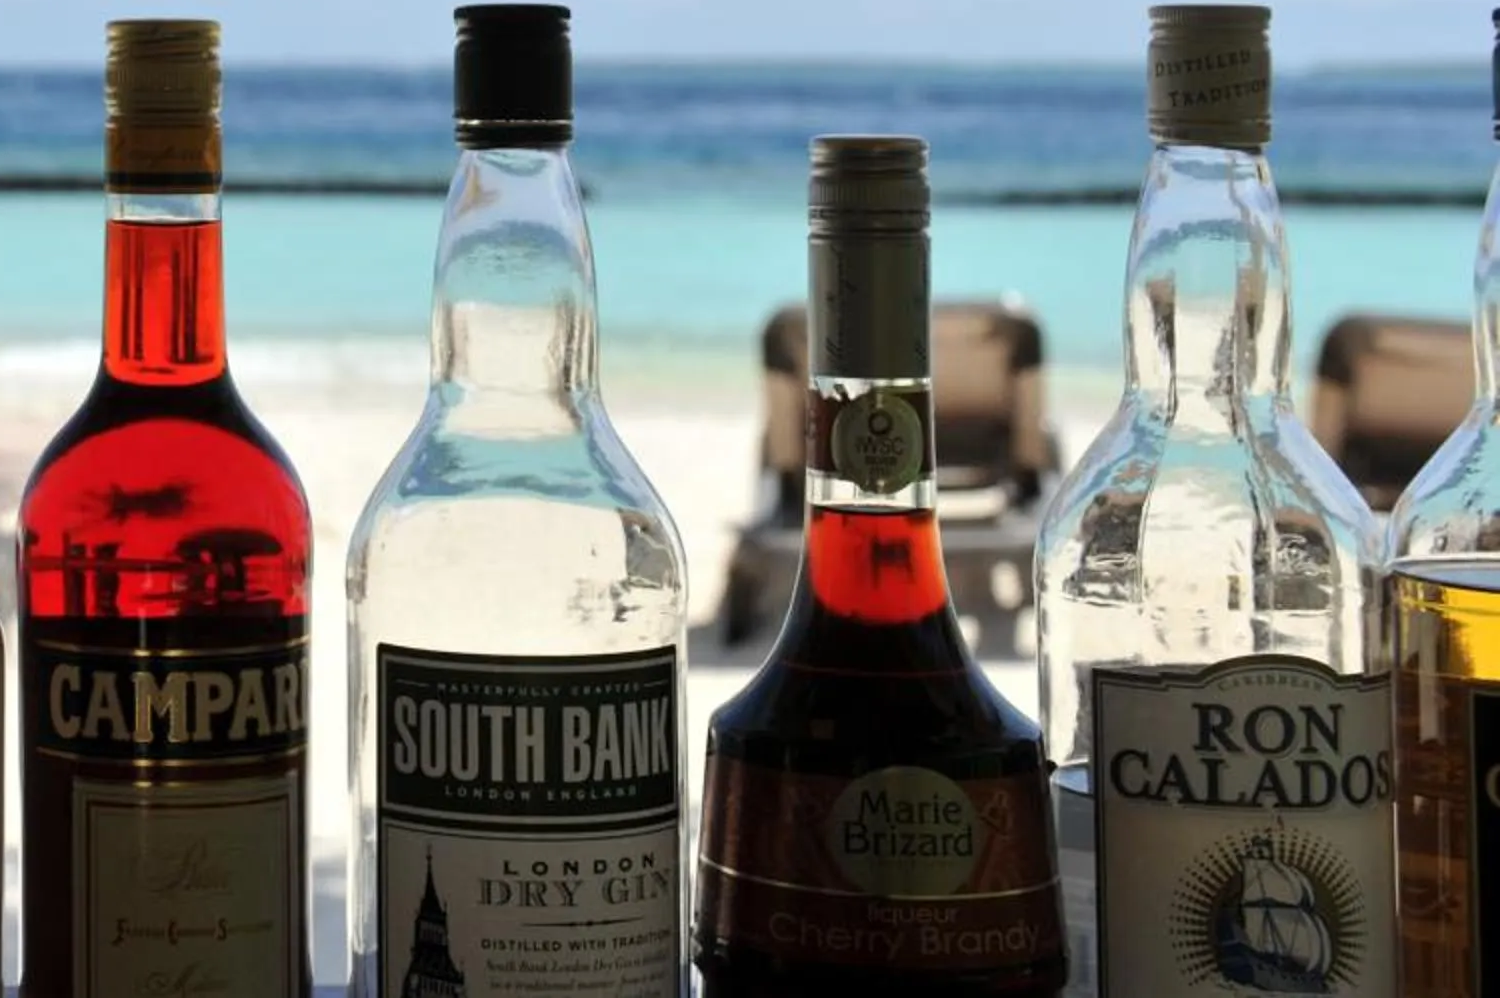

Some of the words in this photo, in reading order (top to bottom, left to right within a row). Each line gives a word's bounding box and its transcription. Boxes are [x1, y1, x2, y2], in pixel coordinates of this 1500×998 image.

[393, 694, 546, 784] SOUTH
[561, 694, 670, 784] BANK
[1191, 703, 1346, 755] RON
[444, 784, 532, 802] LONDON
[1109, 748, 1391, 810] CALADOS
[857, 789, 963, 825] Marie
[843, 821, 975, 858] Brizard
[502, 852, 656, 877] LONDON
[476, 877, 585, 908] DRY
[480, 938, 563, 953] DISTILLED
[567, 939, 607, 953] WITH
[767, 911, 906, 962] Cherry
[919, 919, 1041, 956] Brandy
